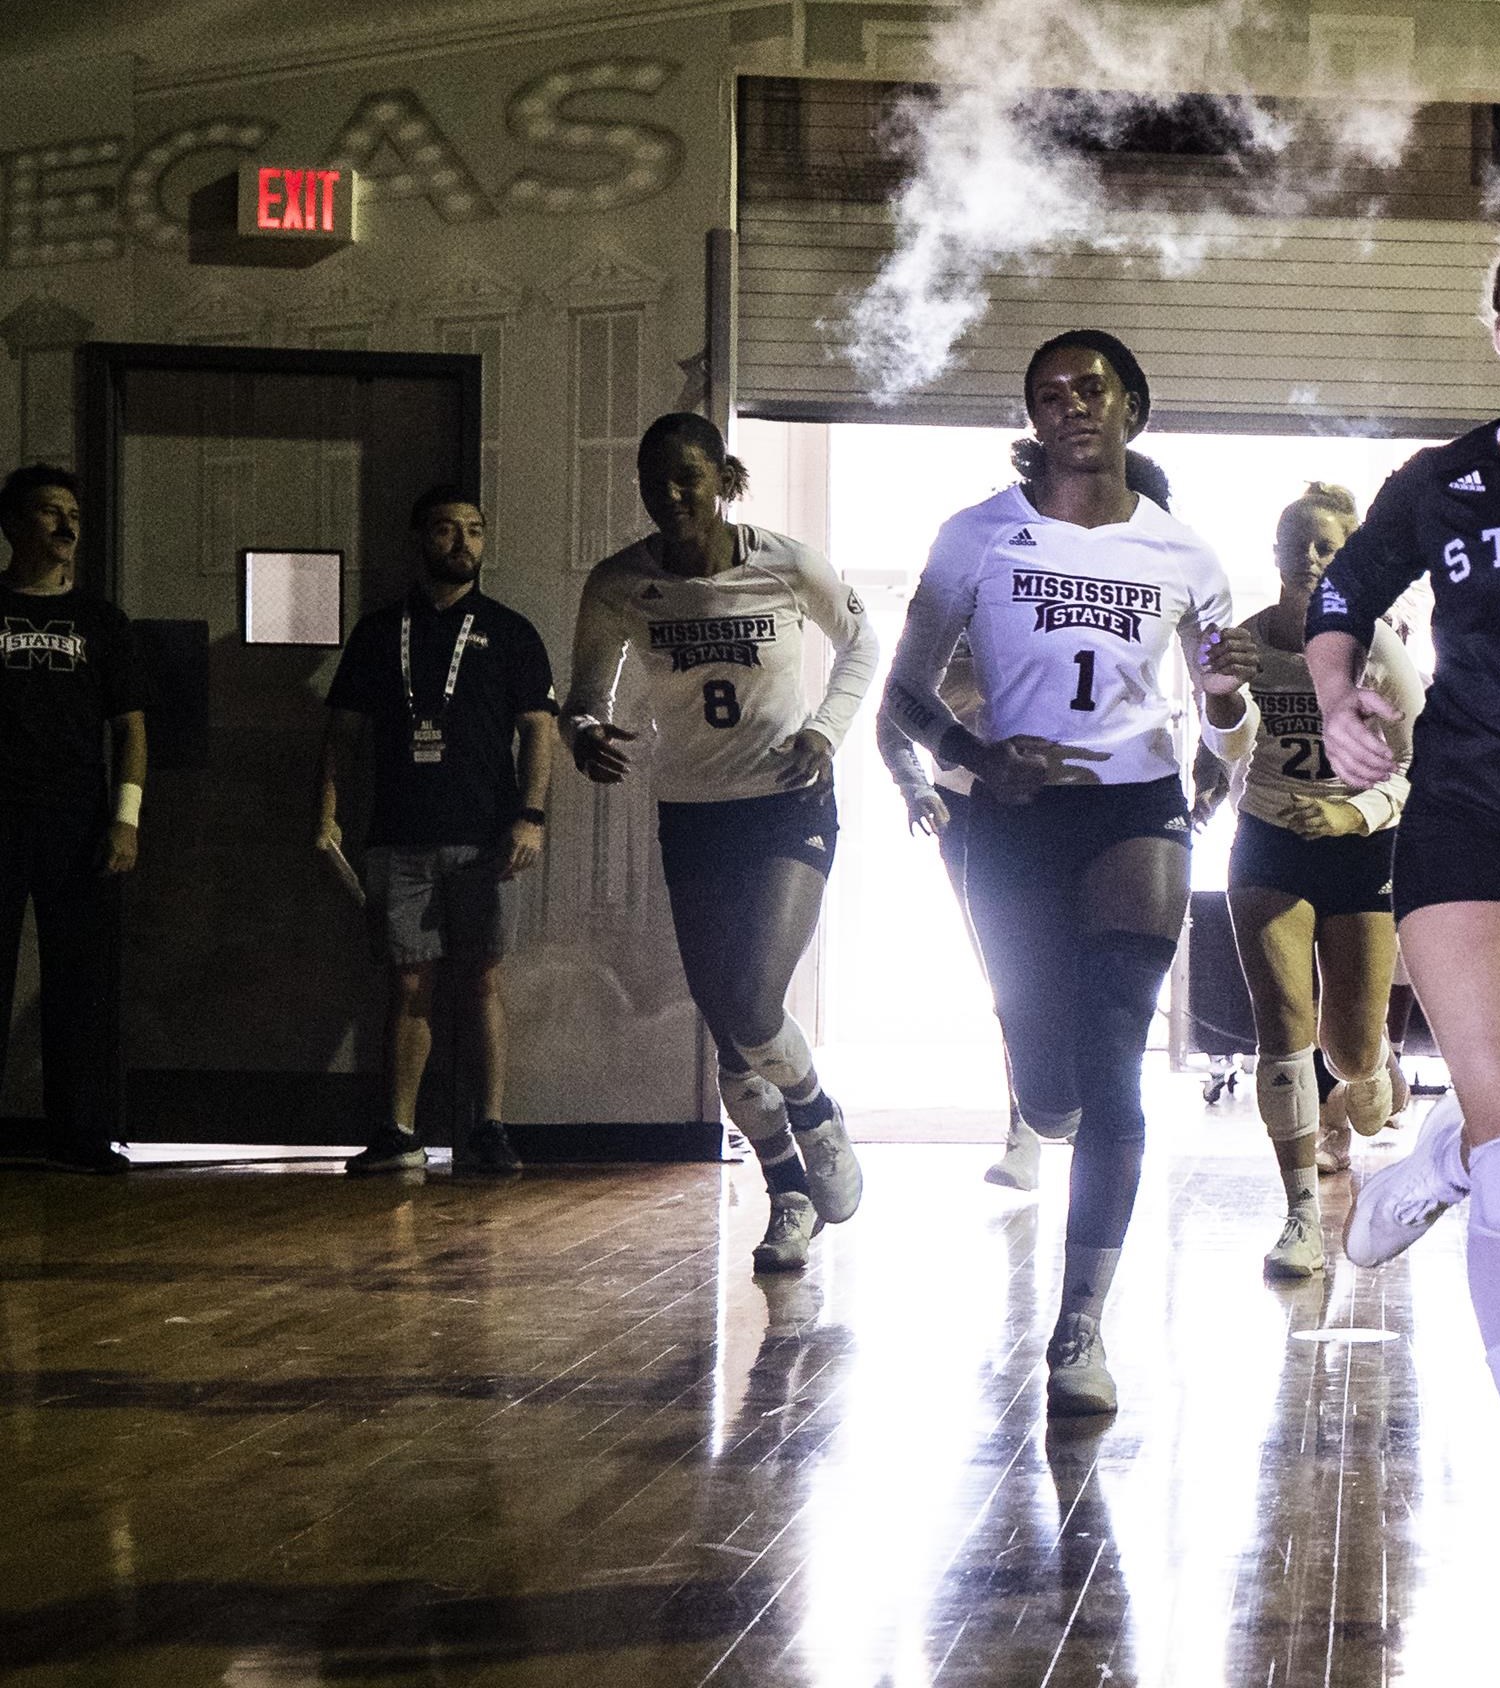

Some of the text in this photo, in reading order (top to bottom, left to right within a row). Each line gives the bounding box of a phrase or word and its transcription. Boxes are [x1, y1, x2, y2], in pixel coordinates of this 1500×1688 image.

[258, 168, 340, 232] EXIT
[1012, 575, 1162, 612] MISSISSIPPI
[651, 618, 776, 644] MISSISSIPPI
[1053, 607, 1124, 633] STATE
[10, 634, 70, 652] STATE
[685, 643, 744, 664] STATE
[1070, 650, 1095, 711] 1
[703, 679, 741, 729] 8
